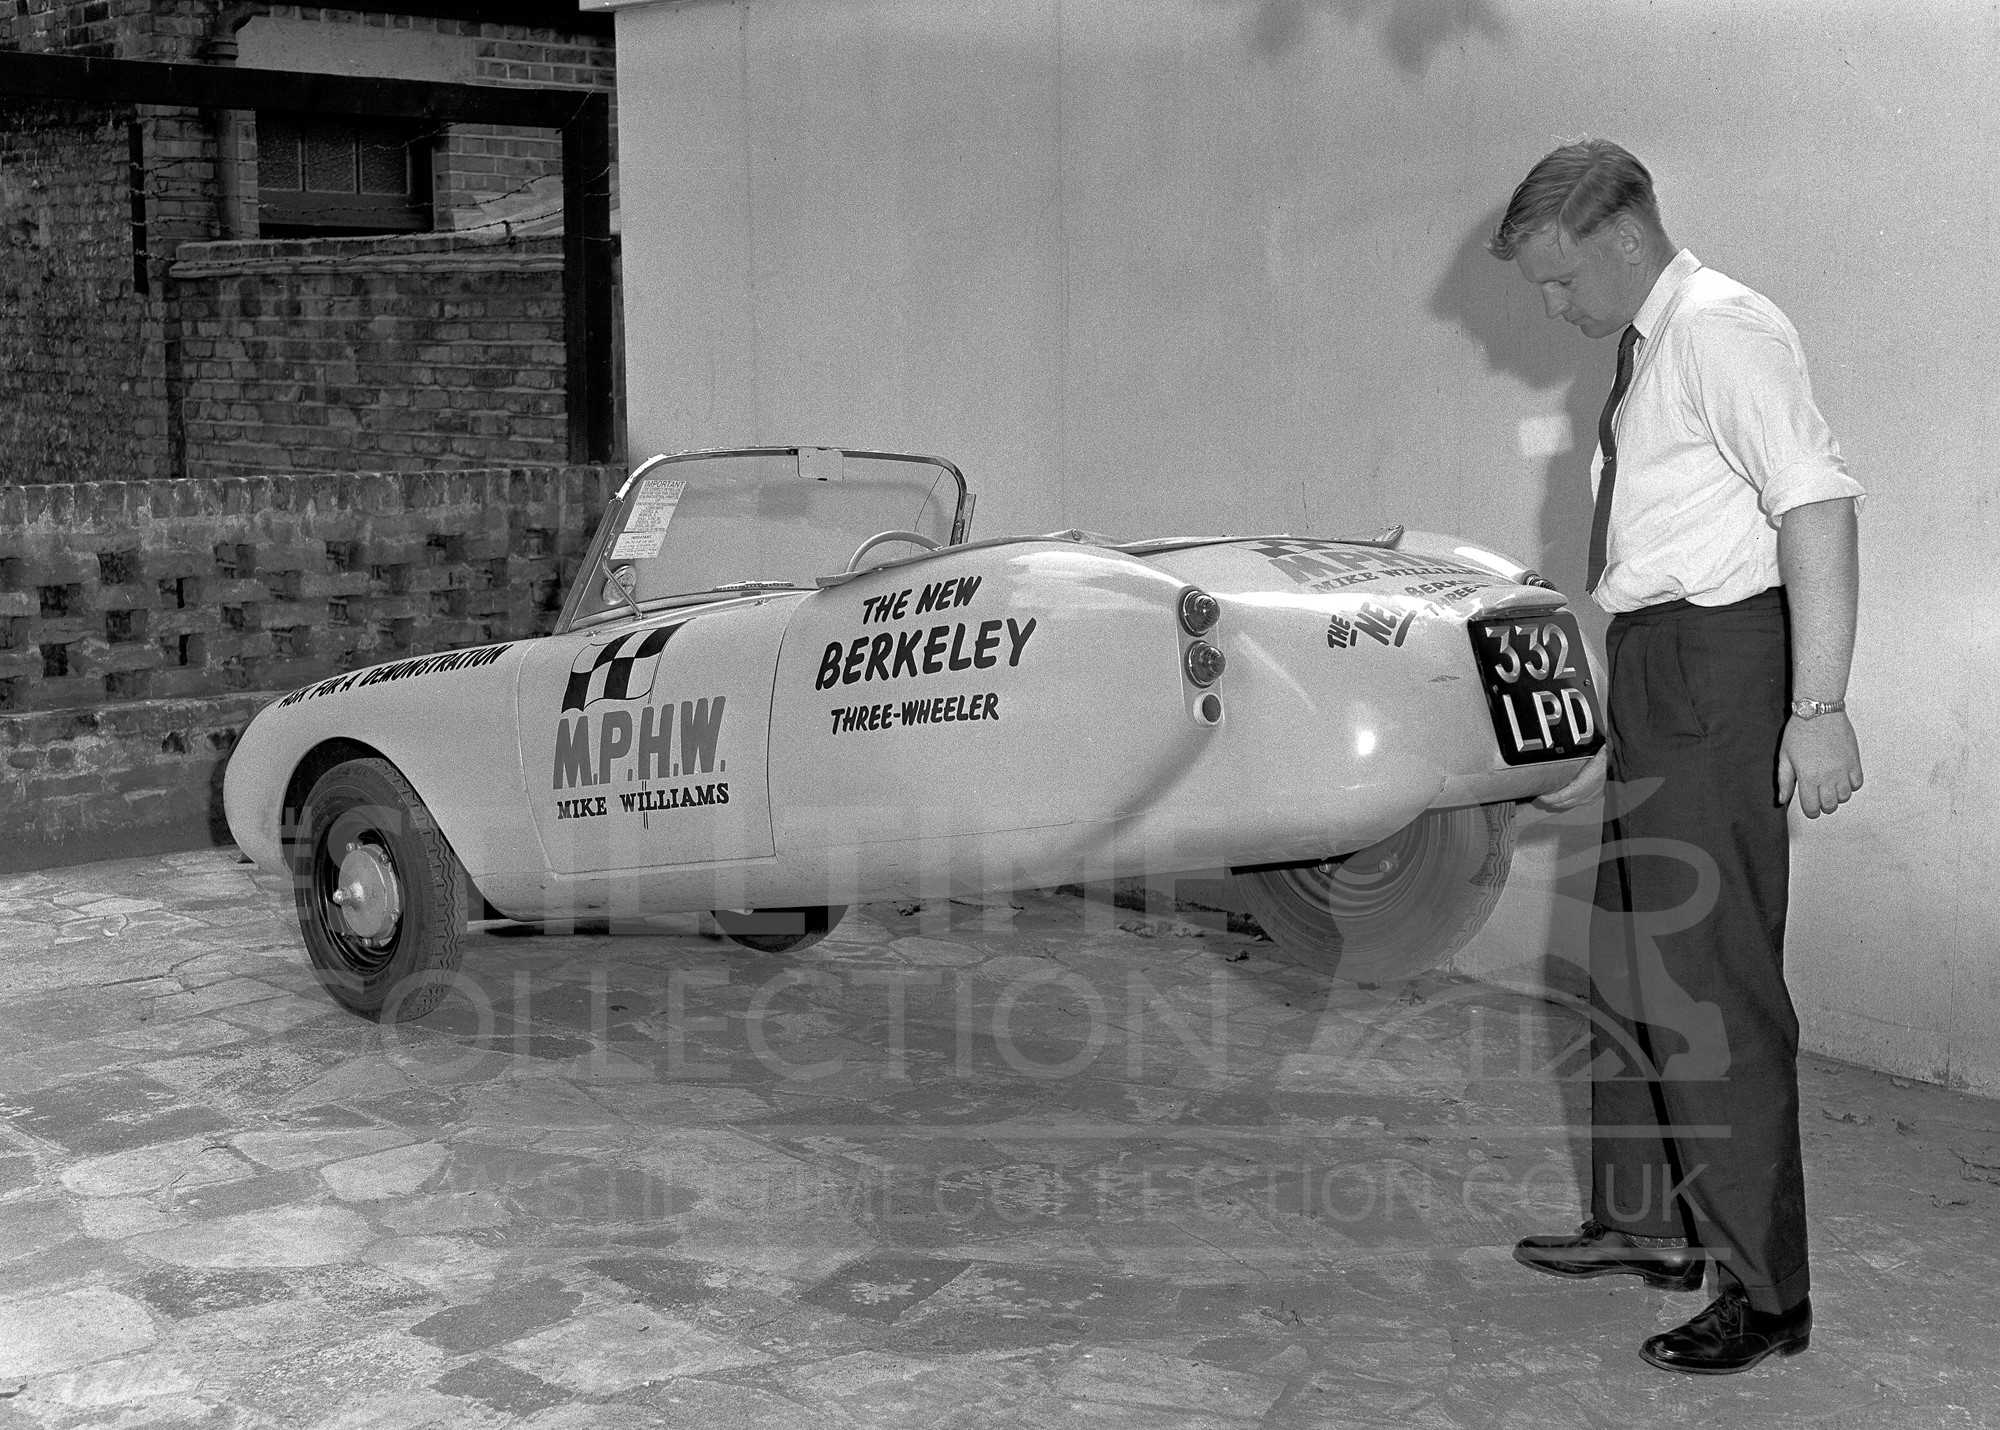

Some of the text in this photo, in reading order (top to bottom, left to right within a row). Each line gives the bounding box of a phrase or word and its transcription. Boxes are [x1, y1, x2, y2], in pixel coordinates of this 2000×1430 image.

[862, 575, 982, 625] THE NEW
[1311, 572, 1380, 592] MIKE
[1326, 602, 1403, 649] THE NE
[309, 675, 348, 700] FOR
[339, 671, 363, 693] A
[358, 643, 514, 688] DEMONSTRATION
[815, 616, 1037, 691] BERKELEY
[1485, 623, 1577, 683] 332
[830, 692, 1000, 736] THREE-WHEELER
[1502, 688, 1595, 752] LPD
[553, 695, 727, 790] M.P.H.W.
[557, 782, 730, 820] MIKE WILLIAMS
